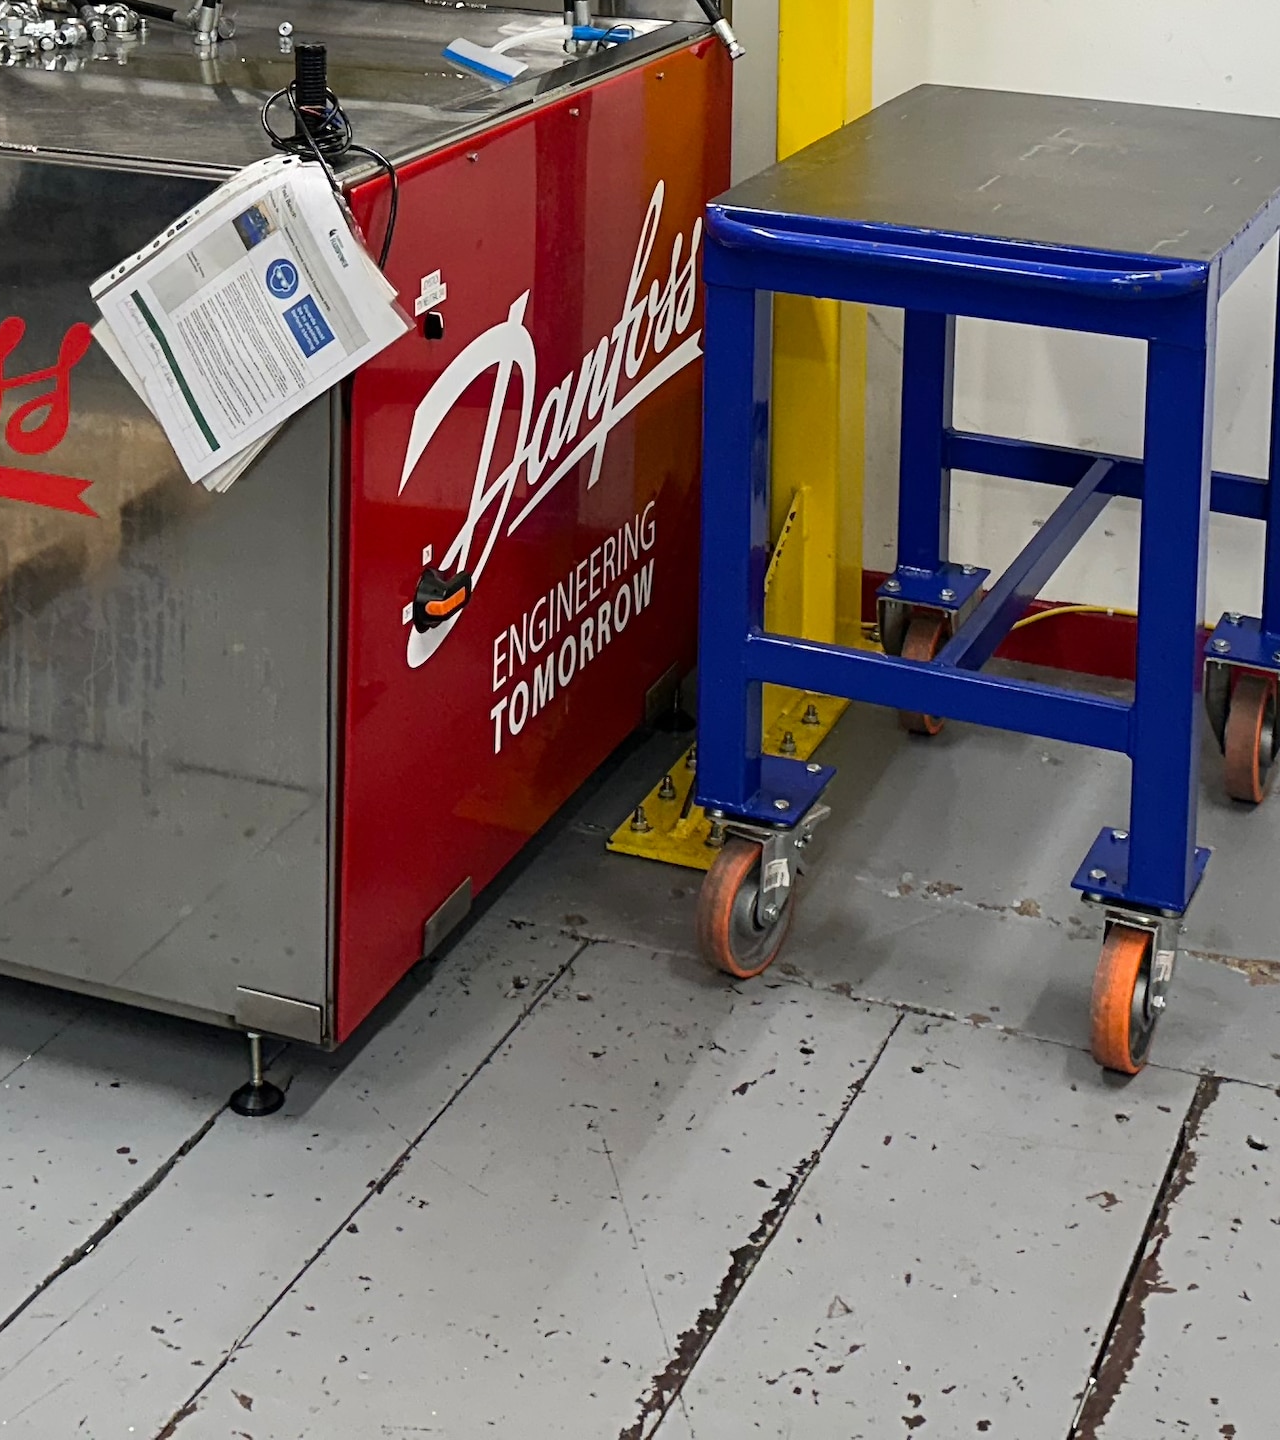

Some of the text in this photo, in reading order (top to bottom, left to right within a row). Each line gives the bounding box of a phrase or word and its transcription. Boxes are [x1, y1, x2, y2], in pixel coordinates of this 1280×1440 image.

[305, 322, 320, 345] position
[398, 179, 702, 669] Danfoss
[490, 558, 656, 755] TOMORROW
[492, 500, 656, 692] ENGINEERING
